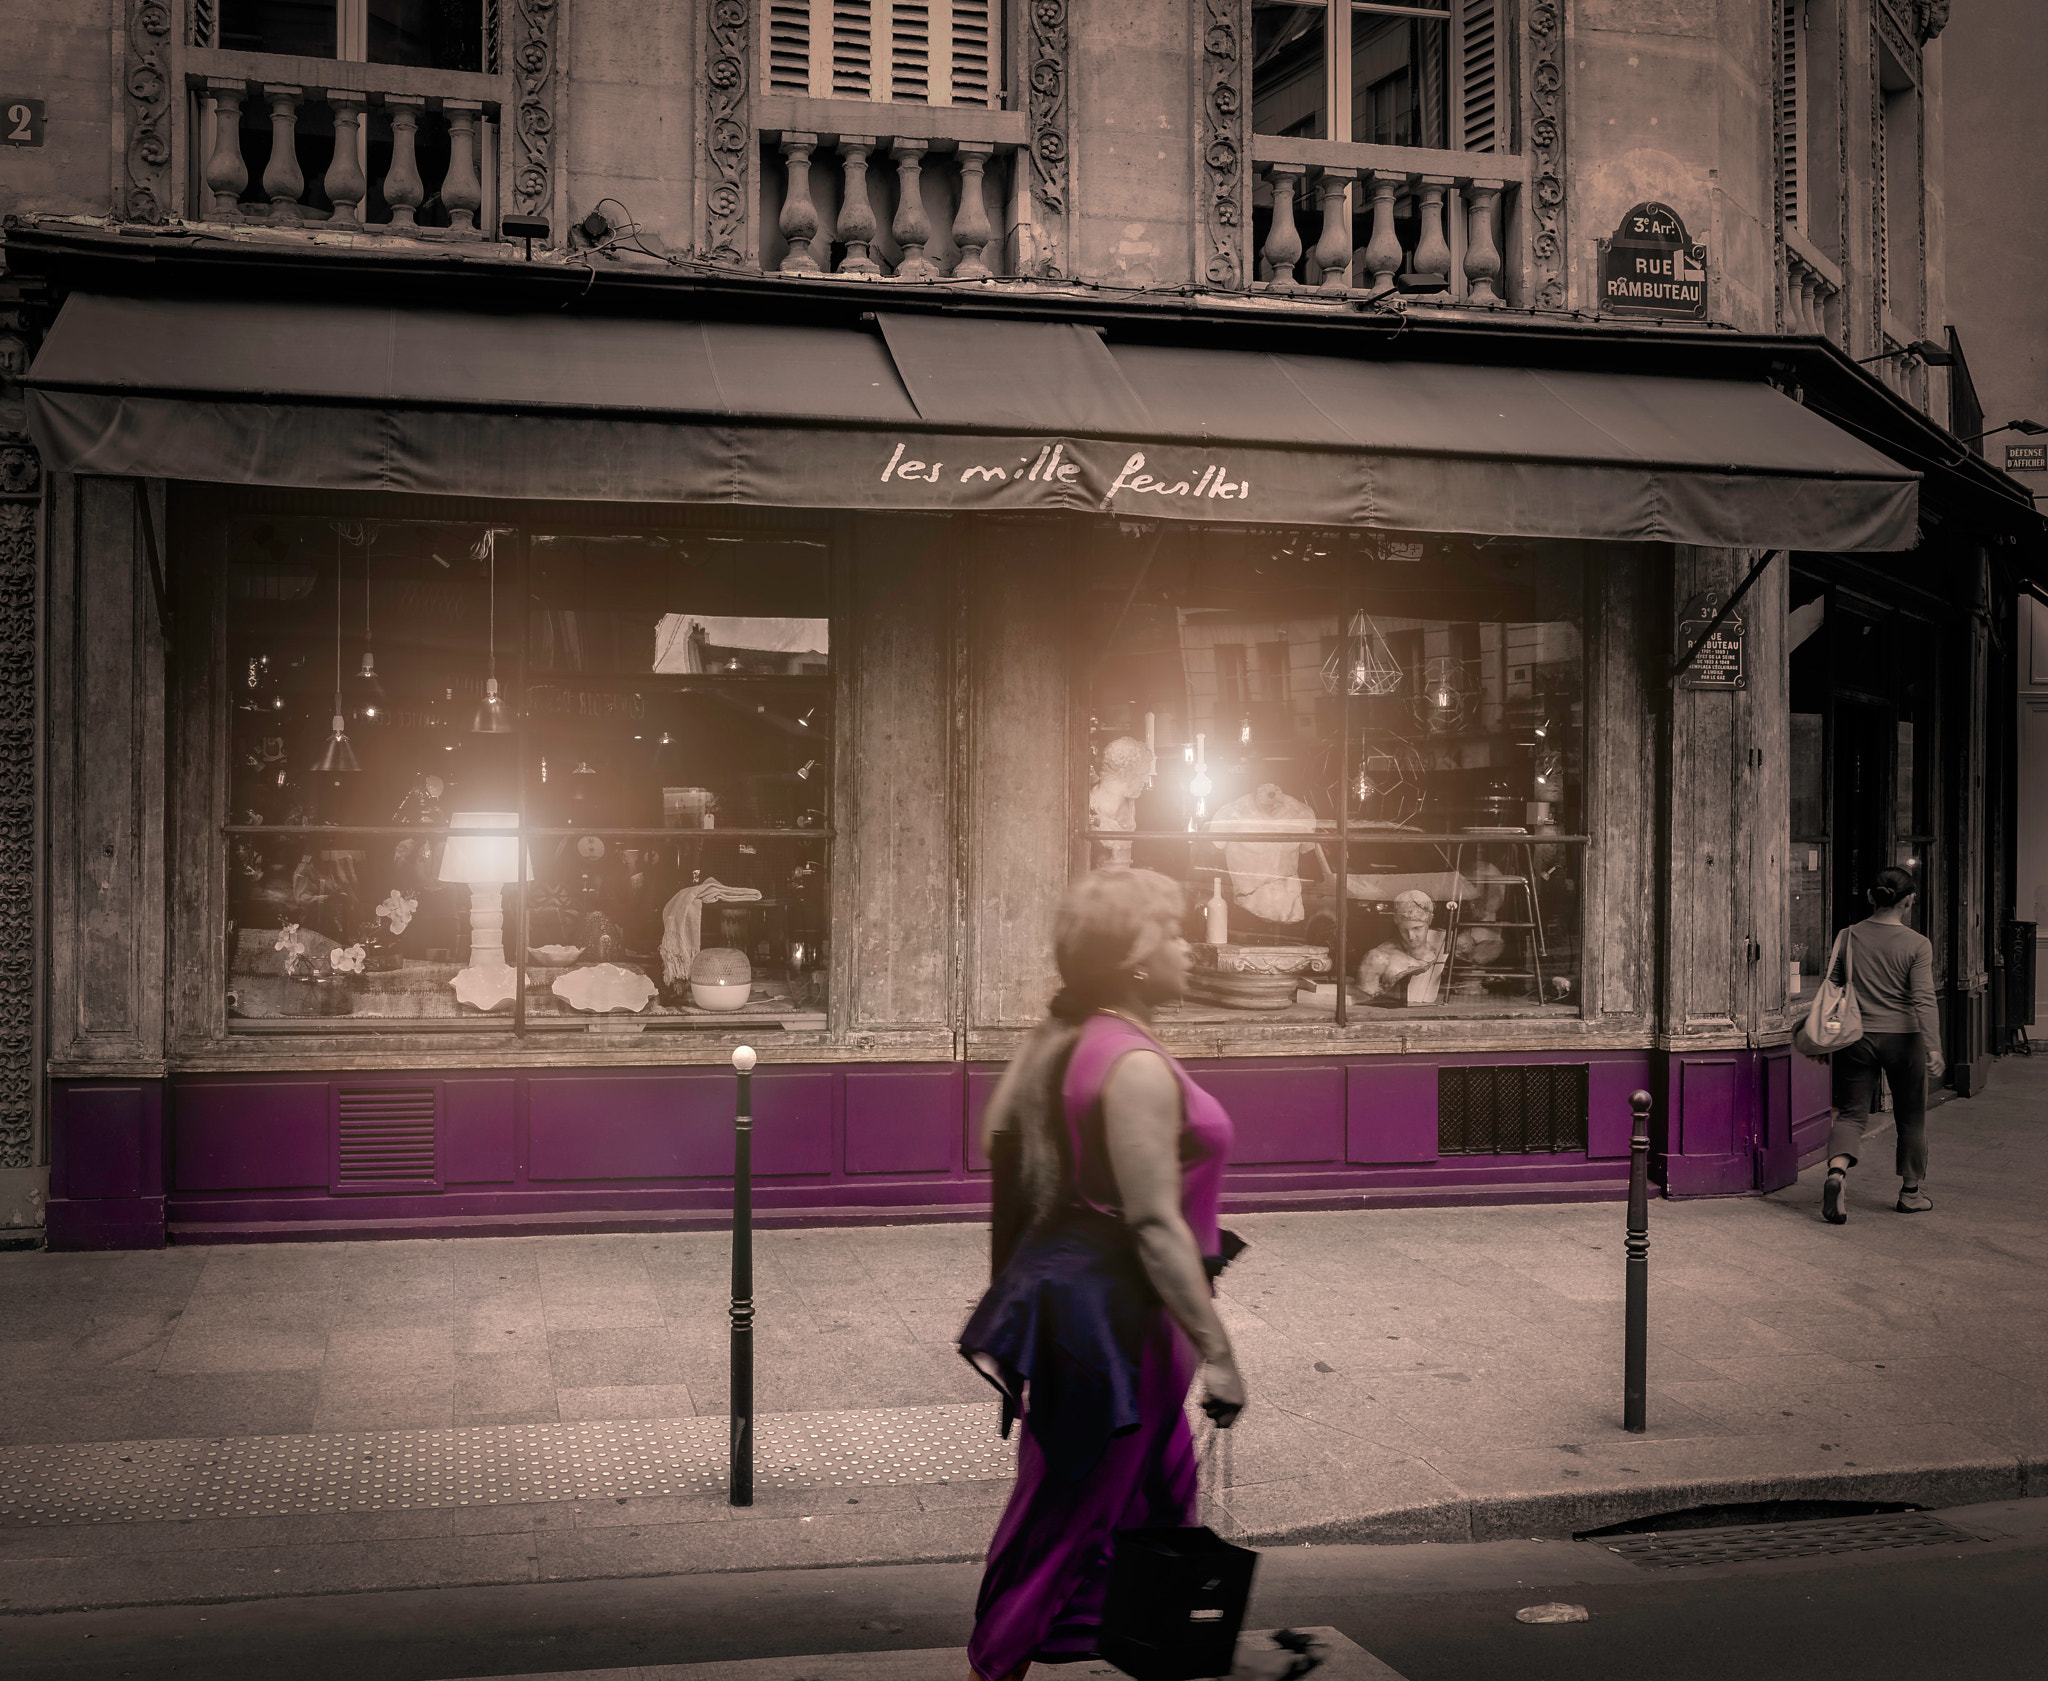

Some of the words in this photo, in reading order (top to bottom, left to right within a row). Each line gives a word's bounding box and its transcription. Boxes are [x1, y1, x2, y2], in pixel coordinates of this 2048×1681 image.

[7, 104, 32, 141] 2
[1635, 258, 1672, 275] RUE
[1607, 280, 1699, 301] RAMBUTEAU
[2009, 448, 2043, 457] DÉFENSE
[2007, 459, 2045, 467] D'AFFICHER
[881, 442, 943, 483] les
[960, 443, 1082, 484] mille
[1099, 451, 1249, 511] feuilles
[1708, 632, 1722, 641] UE
[1687, 640, 1739, 650] RBUTEAU
